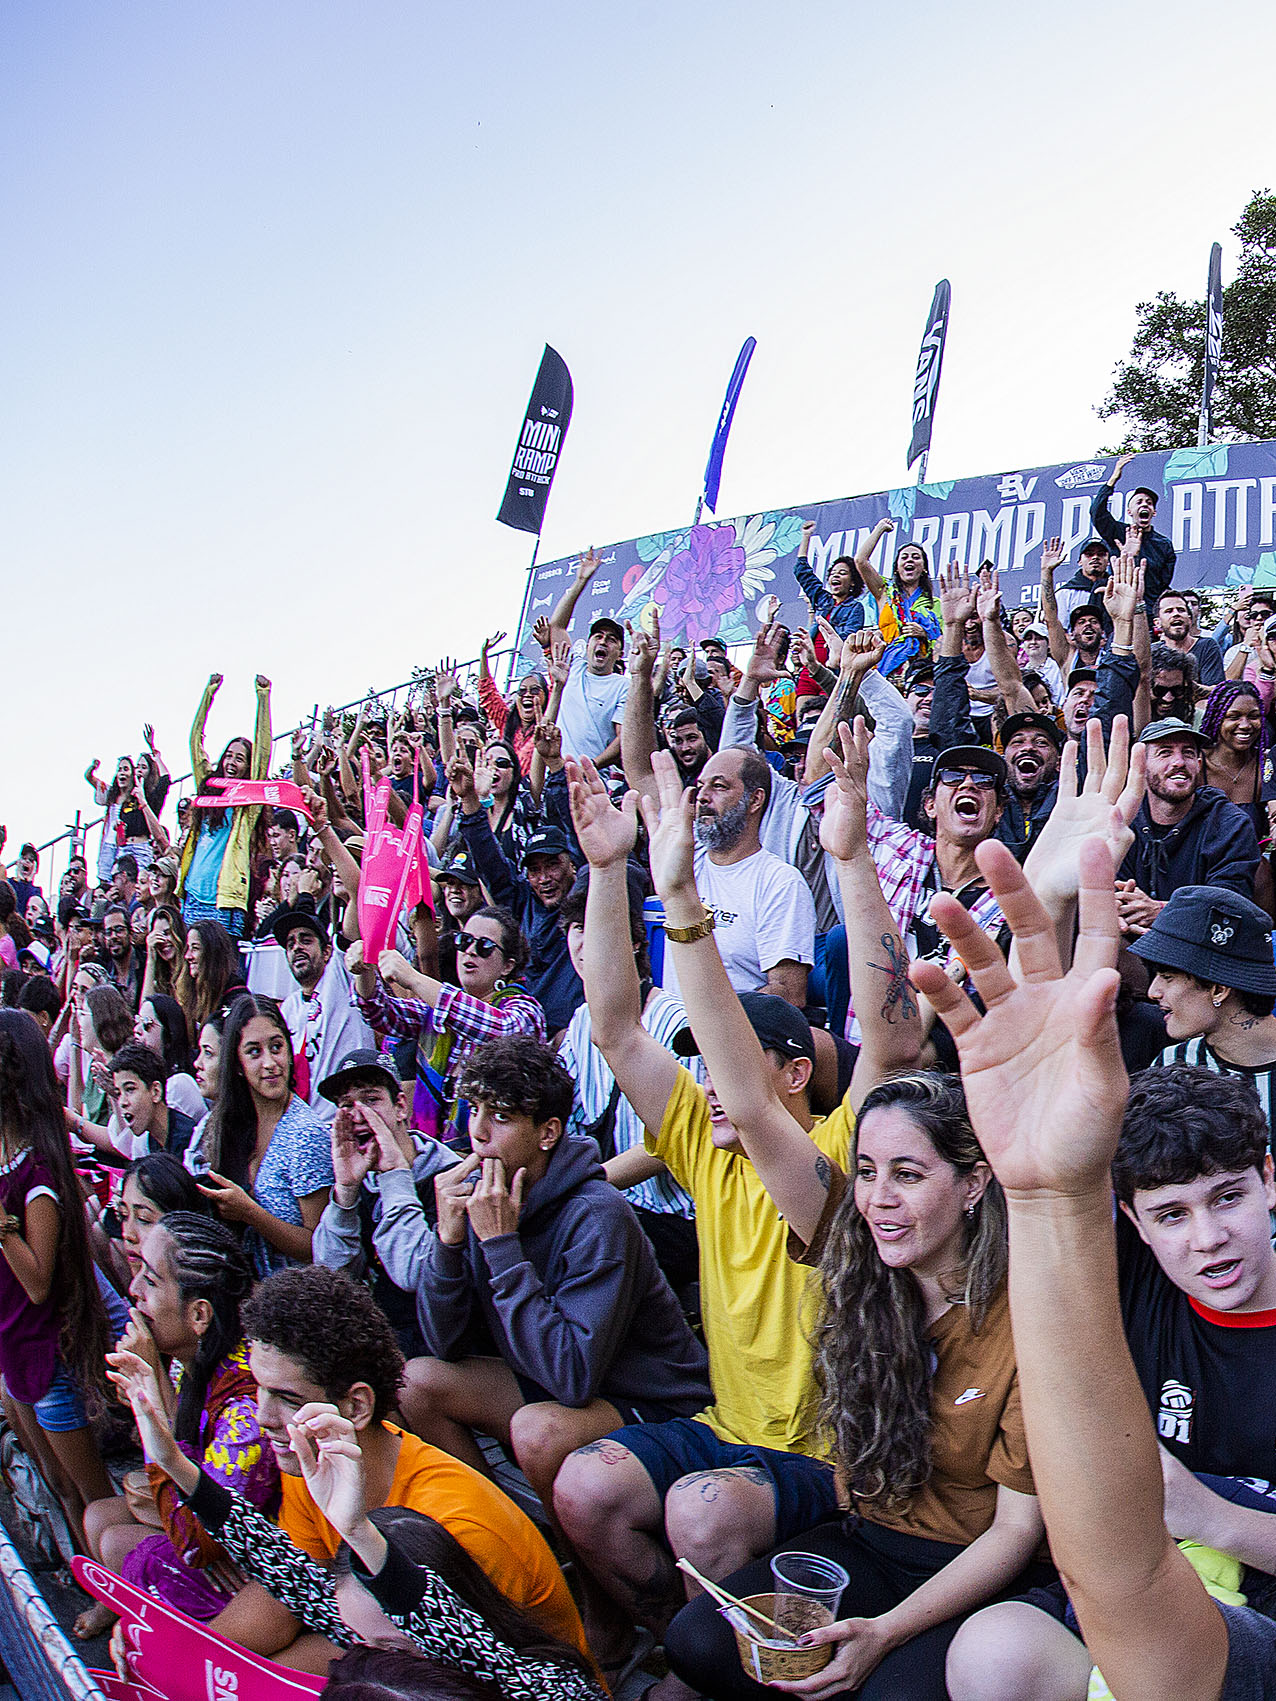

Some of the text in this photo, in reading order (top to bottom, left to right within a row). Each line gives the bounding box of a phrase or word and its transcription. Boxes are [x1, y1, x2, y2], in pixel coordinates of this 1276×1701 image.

[912, 318, 944, 427] VANS
[513, 444, 558, 475] RAMP
[1073, 475, 1086, 484] THE
[908, 501, 1046, 583] RAMP
